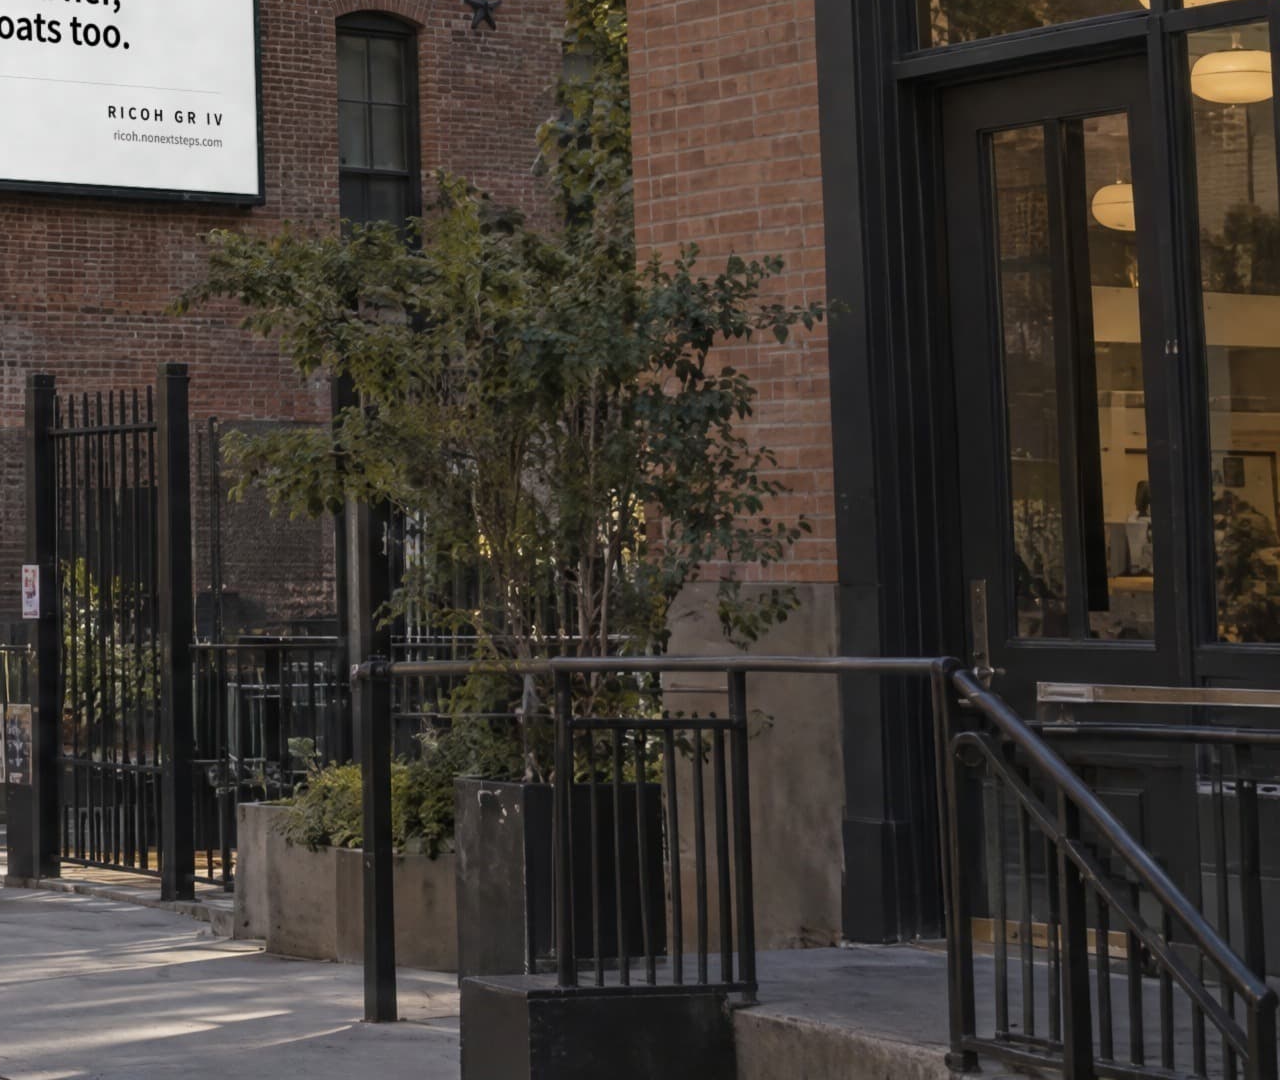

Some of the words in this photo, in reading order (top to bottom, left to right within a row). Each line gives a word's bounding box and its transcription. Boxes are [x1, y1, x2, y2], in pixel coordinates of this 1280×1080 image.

[69, 16, 130, 50] too.
[107, 105, 163, 122] RICOH
[174, 110, 196, 125] GR
[206, 112, 223, 126] IV
[113, 129, 223, 148] ricoh.nonextsteps.com
